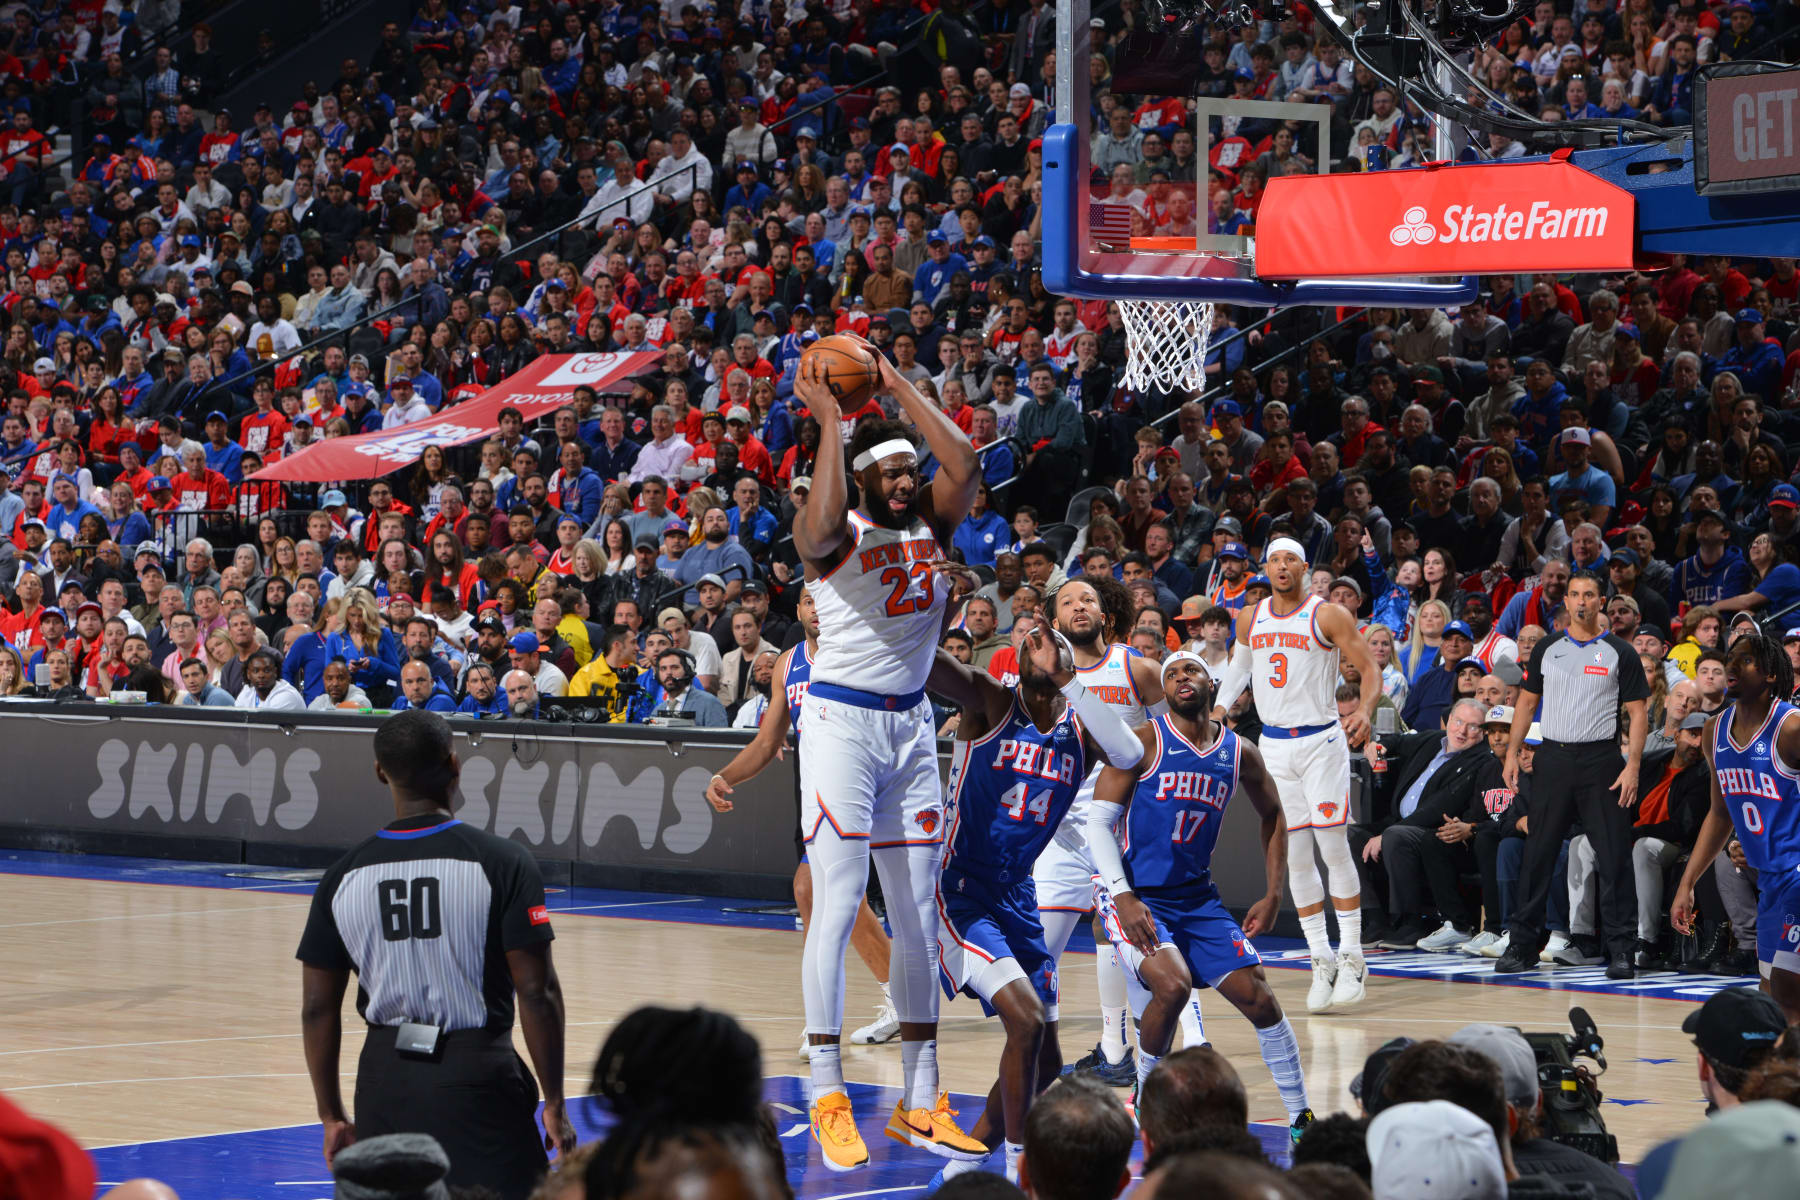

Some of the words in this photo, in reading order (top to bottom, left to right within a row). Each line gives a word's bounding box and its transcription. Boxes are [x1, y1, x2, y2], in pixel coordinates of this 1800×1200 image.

[1733, 88, 1798, 162] GET
[1439, 204, 1524, 243] State
[1524, 201, 1609, 239] Farm
[859, 543, 899, 574] NEW
[898, 539, 937, 563] YORK
[880, 561, 934, 617] 23
[1251, 632, 1276, 651] NEW
[1278, 632, 1310, 652] YORK
[1269, 653, 1288, 688] 3
[88, 738, 321, 830] SKIMS
[992, 739, 1076, 787] PHILA
[454, 755, 714, 855] SKIMS
[1000, 782, 1055, 826] 44
[1156, 771, 1229, 811] PHILA
[1717, 768, 1782, 801] PHILA
[1172, 810, 1208, 844] 17
[1742, 802, 1764, 835] 0
[378, 877, 442, 942] 60
